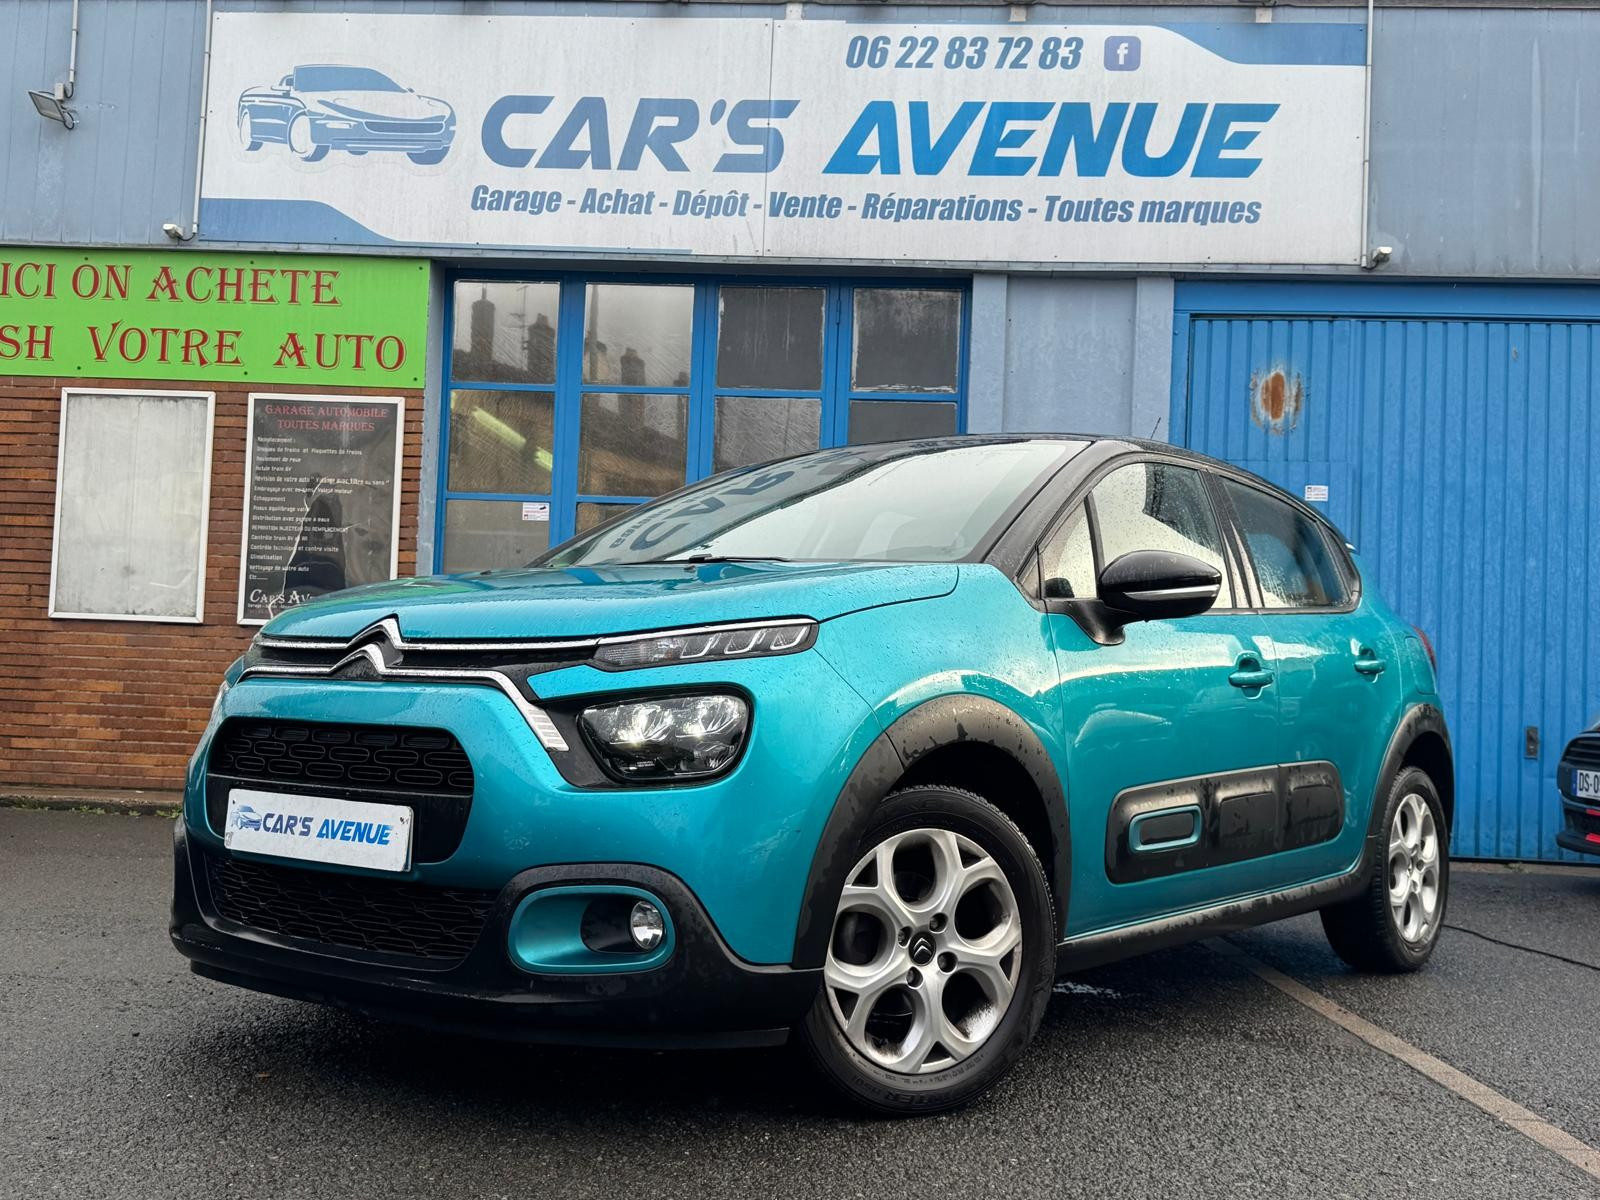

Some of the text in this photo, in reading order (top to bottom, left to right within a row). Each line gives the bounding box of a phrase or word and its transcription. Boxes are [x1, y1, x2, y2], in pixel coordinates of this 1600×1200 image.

[846, 36, 1084, 70] 06 22 83 72 83
[481, 96, 1281, 179] CAR'S AVENUE
[471, 184, 561, 216] Garage
[579, 188, 655, 215] Achat
[672, 189, 750, 219] Dépôt
[768, 191, 842, 219] Vente
[861, 192, 1023, 222] Réparations
[1044, 195, 1134, 224] Toutes
[1137, 198, 1262, 227] marques
[1, 262, 342, 306] ICI ON ACHETE
[88, 320, 243, 366] VOTRE
[273, 332, 407, 371] AUTO
[264, 404, 389, 418] GARAGE AUTOMOBILE
[277, 419, 375, 431] TOUTES MARQUES
[262, 812, 393, 846] CAR'S AVENUE
